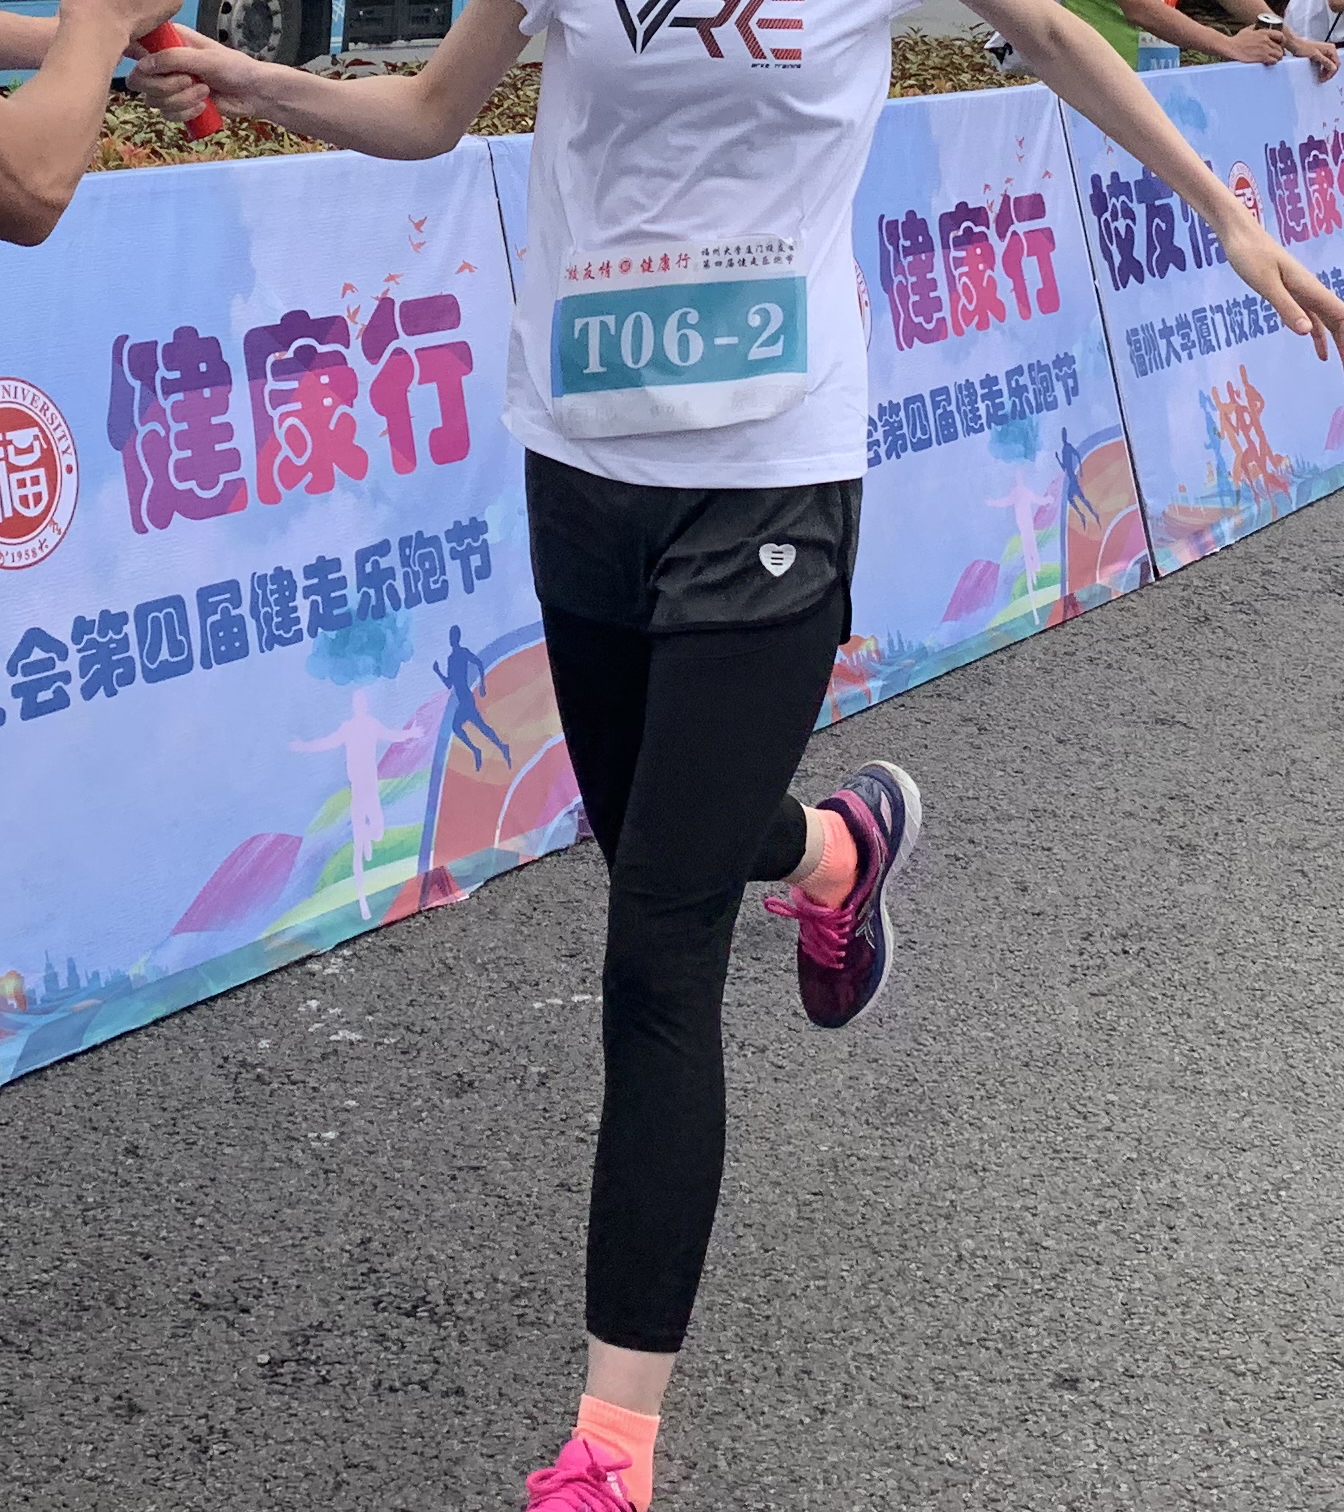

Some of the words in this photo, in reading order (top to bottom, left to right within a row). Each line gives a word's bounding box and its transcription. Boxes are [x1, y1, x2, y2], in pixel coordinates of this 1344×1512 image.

[564, 259, 612, 281] 校友情
[639, 252, 692, 275] 健康行
[878, 192, 1061, 352] 健康行
[573, 302, 786, 375] T06-2
[106, 293, 475, 535] 健康行
